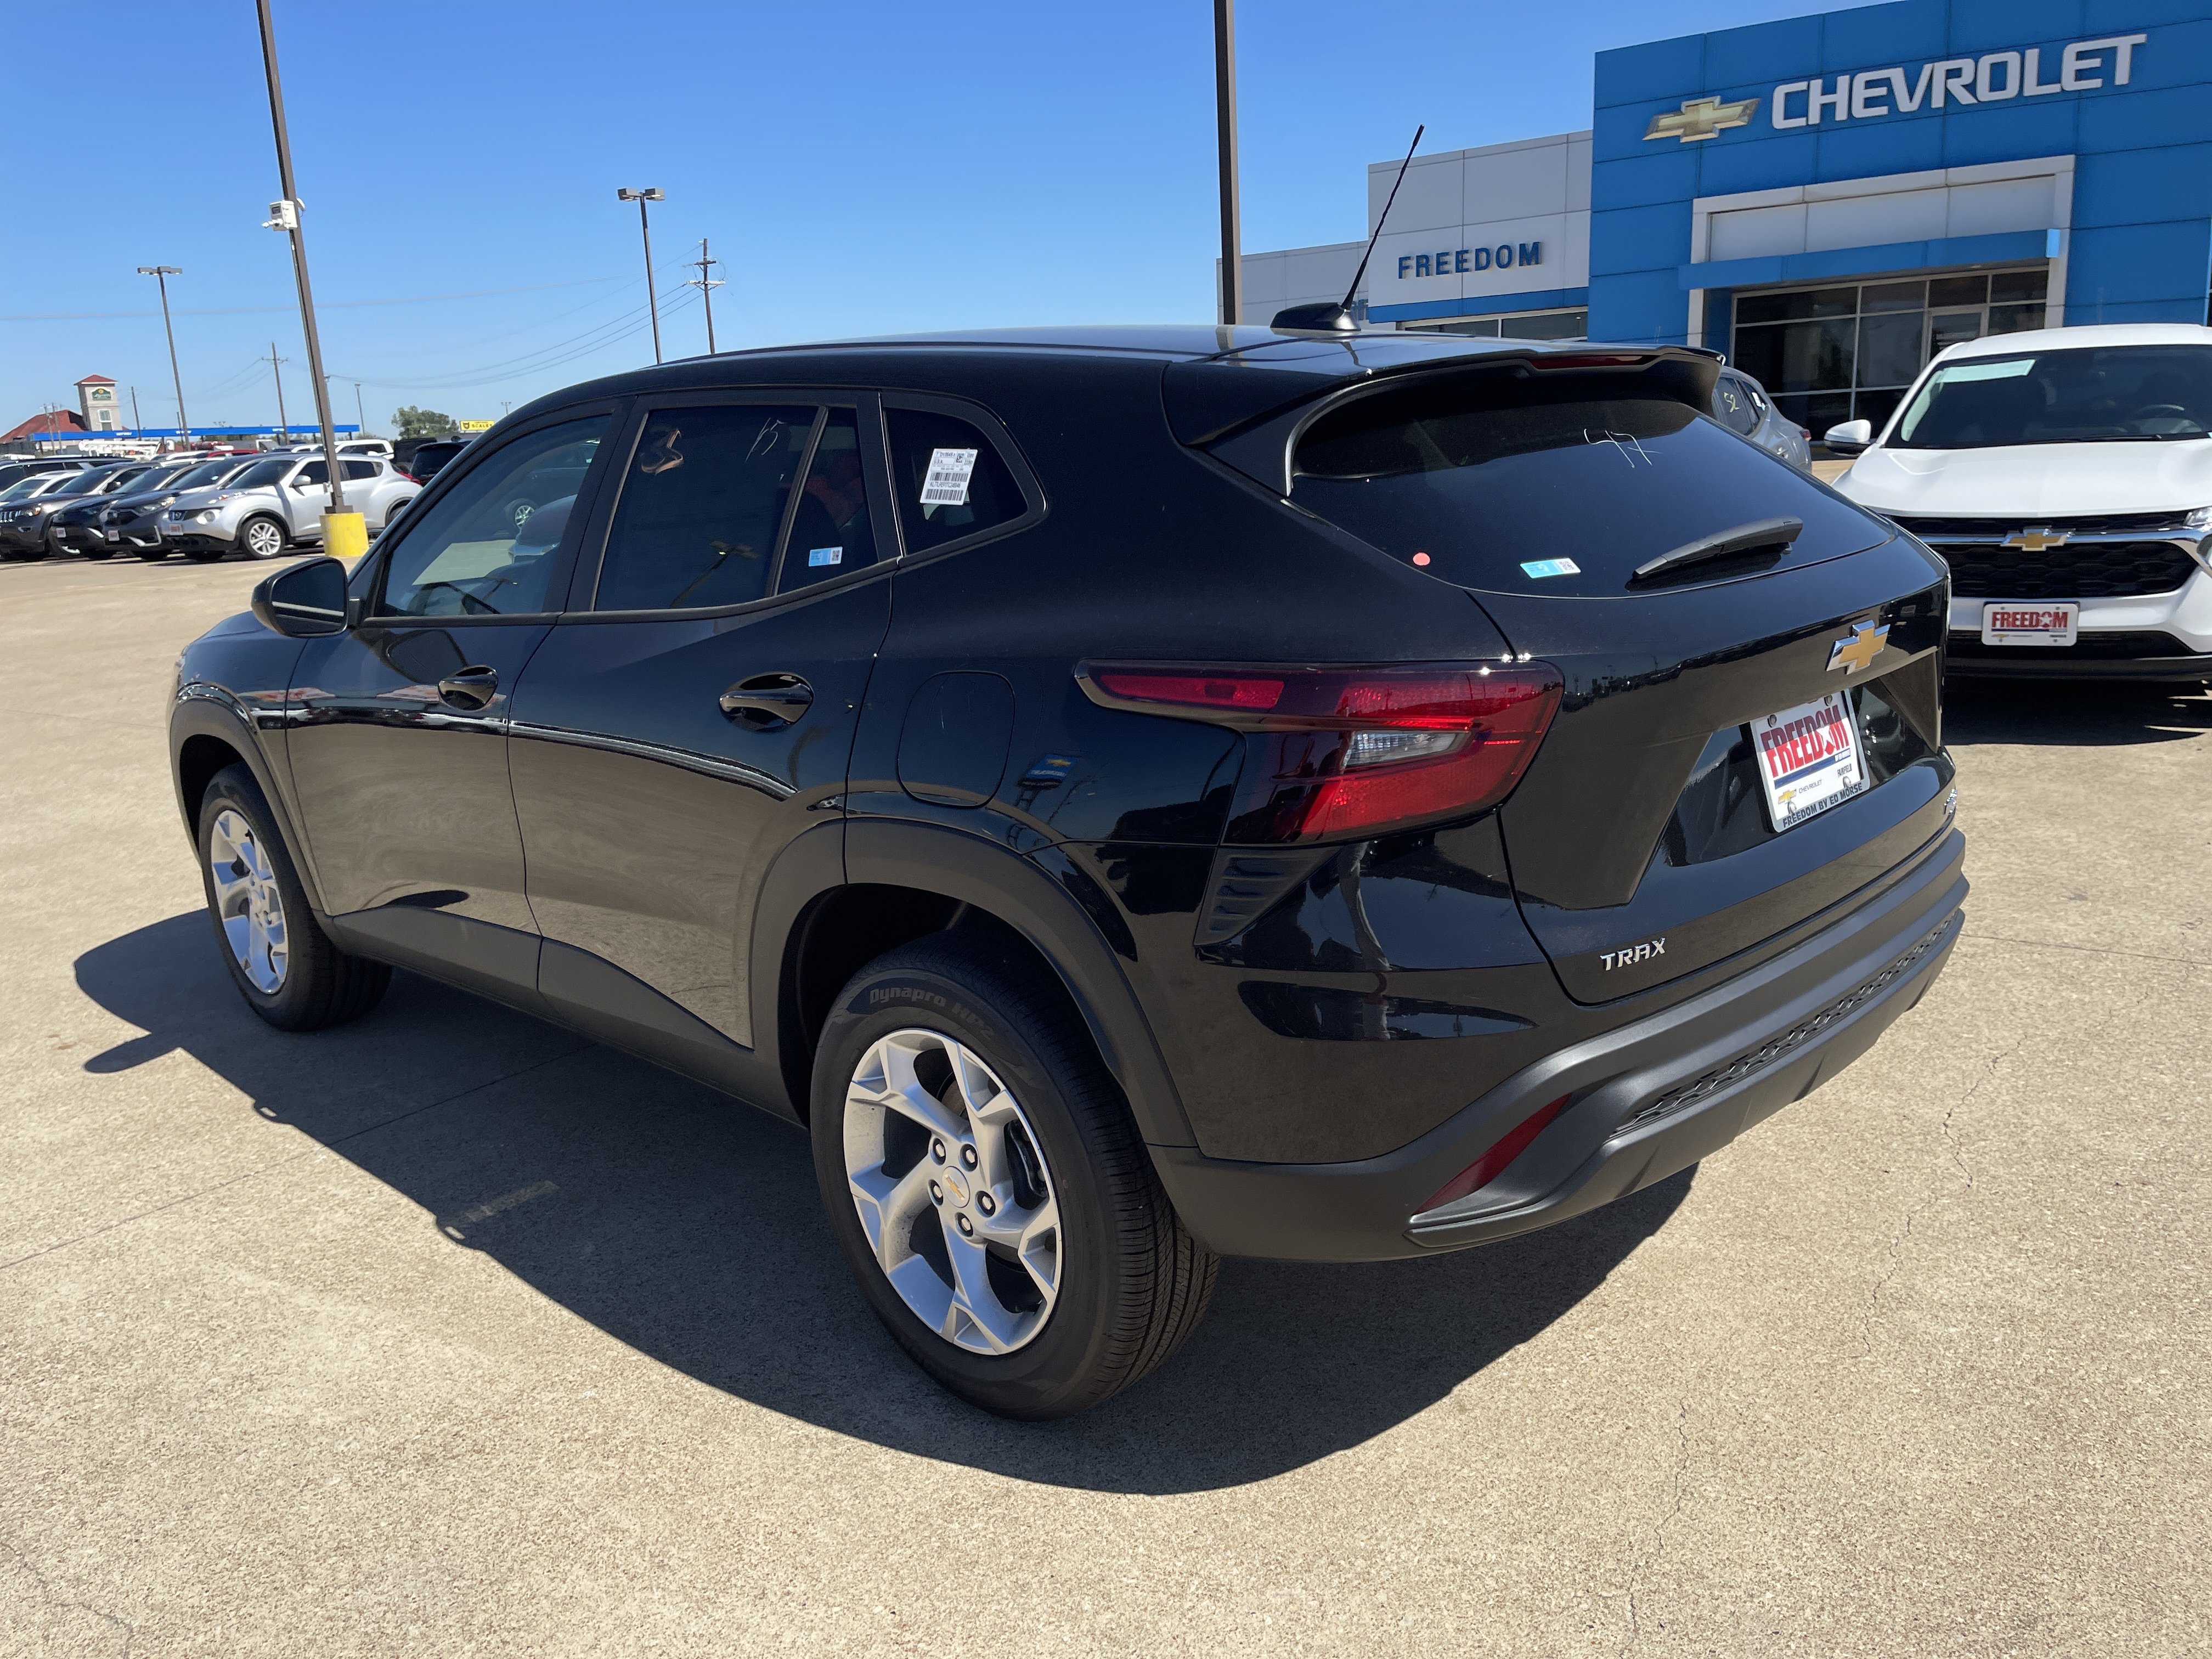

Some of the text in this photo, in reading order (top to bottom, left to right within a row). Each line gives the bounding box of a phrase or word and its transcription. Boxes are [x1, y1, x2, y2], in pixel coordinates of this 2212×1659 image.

[1772, 34, 2147, 129] CHEVROLET
[1398, 241, 1542, 279] FREEDOM
[1992, 612, 2068, 628] FREEDOM
[1760, 704, 1849, 778] FREEDOM
[1783, 782, 1863, 827] FREEDOM BY ED MORSE
[1798, 780, 1822, 793] CHEVROLET
[1600, 937, 1666, 971] TRAX
[870, 988, 946, 1007] Dynapro
